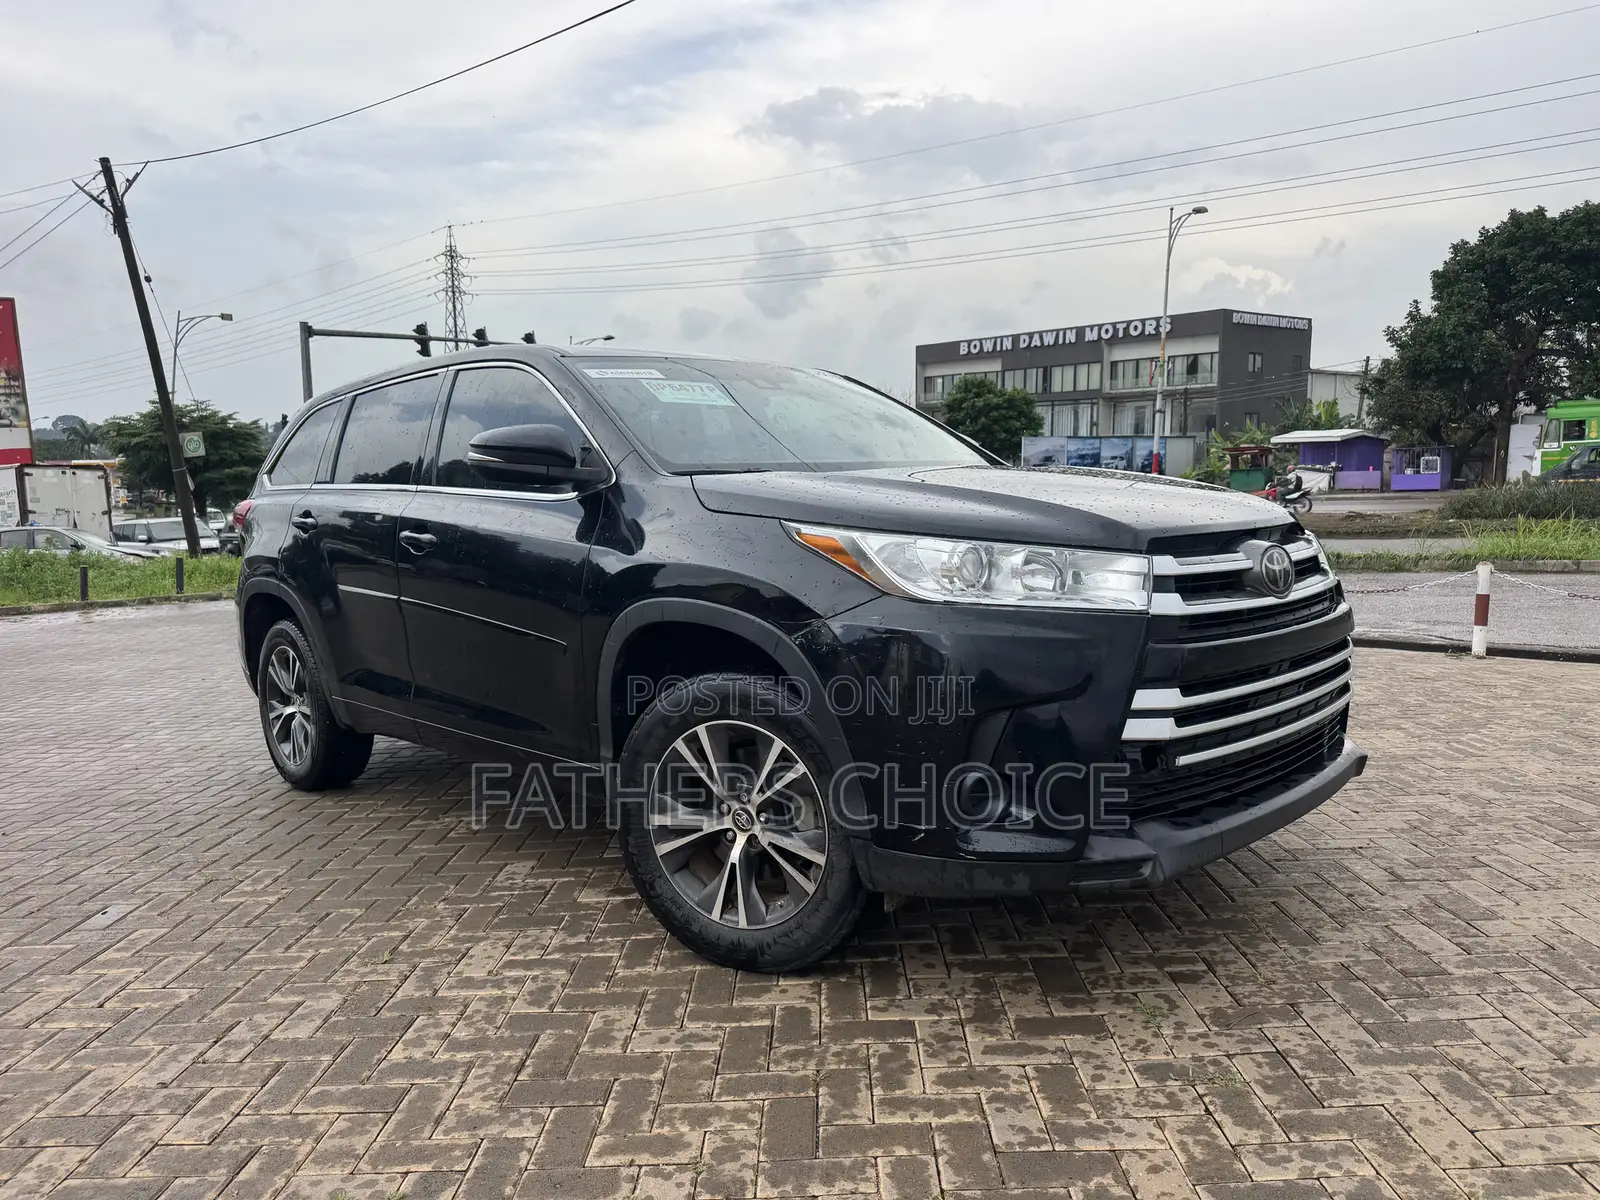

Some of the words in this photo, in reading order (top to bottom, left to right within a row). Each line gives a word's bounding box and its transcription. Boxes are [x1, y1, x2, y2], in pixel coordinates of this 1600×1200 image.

[1232, 312, 1258, 325] BOWIN
[1279, 317, 1309, 330] MOTORS
[959, 336, 1013, 356] BOWIN
[1019, 328, 1077, 349] DAWIN
[1084, 316, 1172, 342] MOTORS
